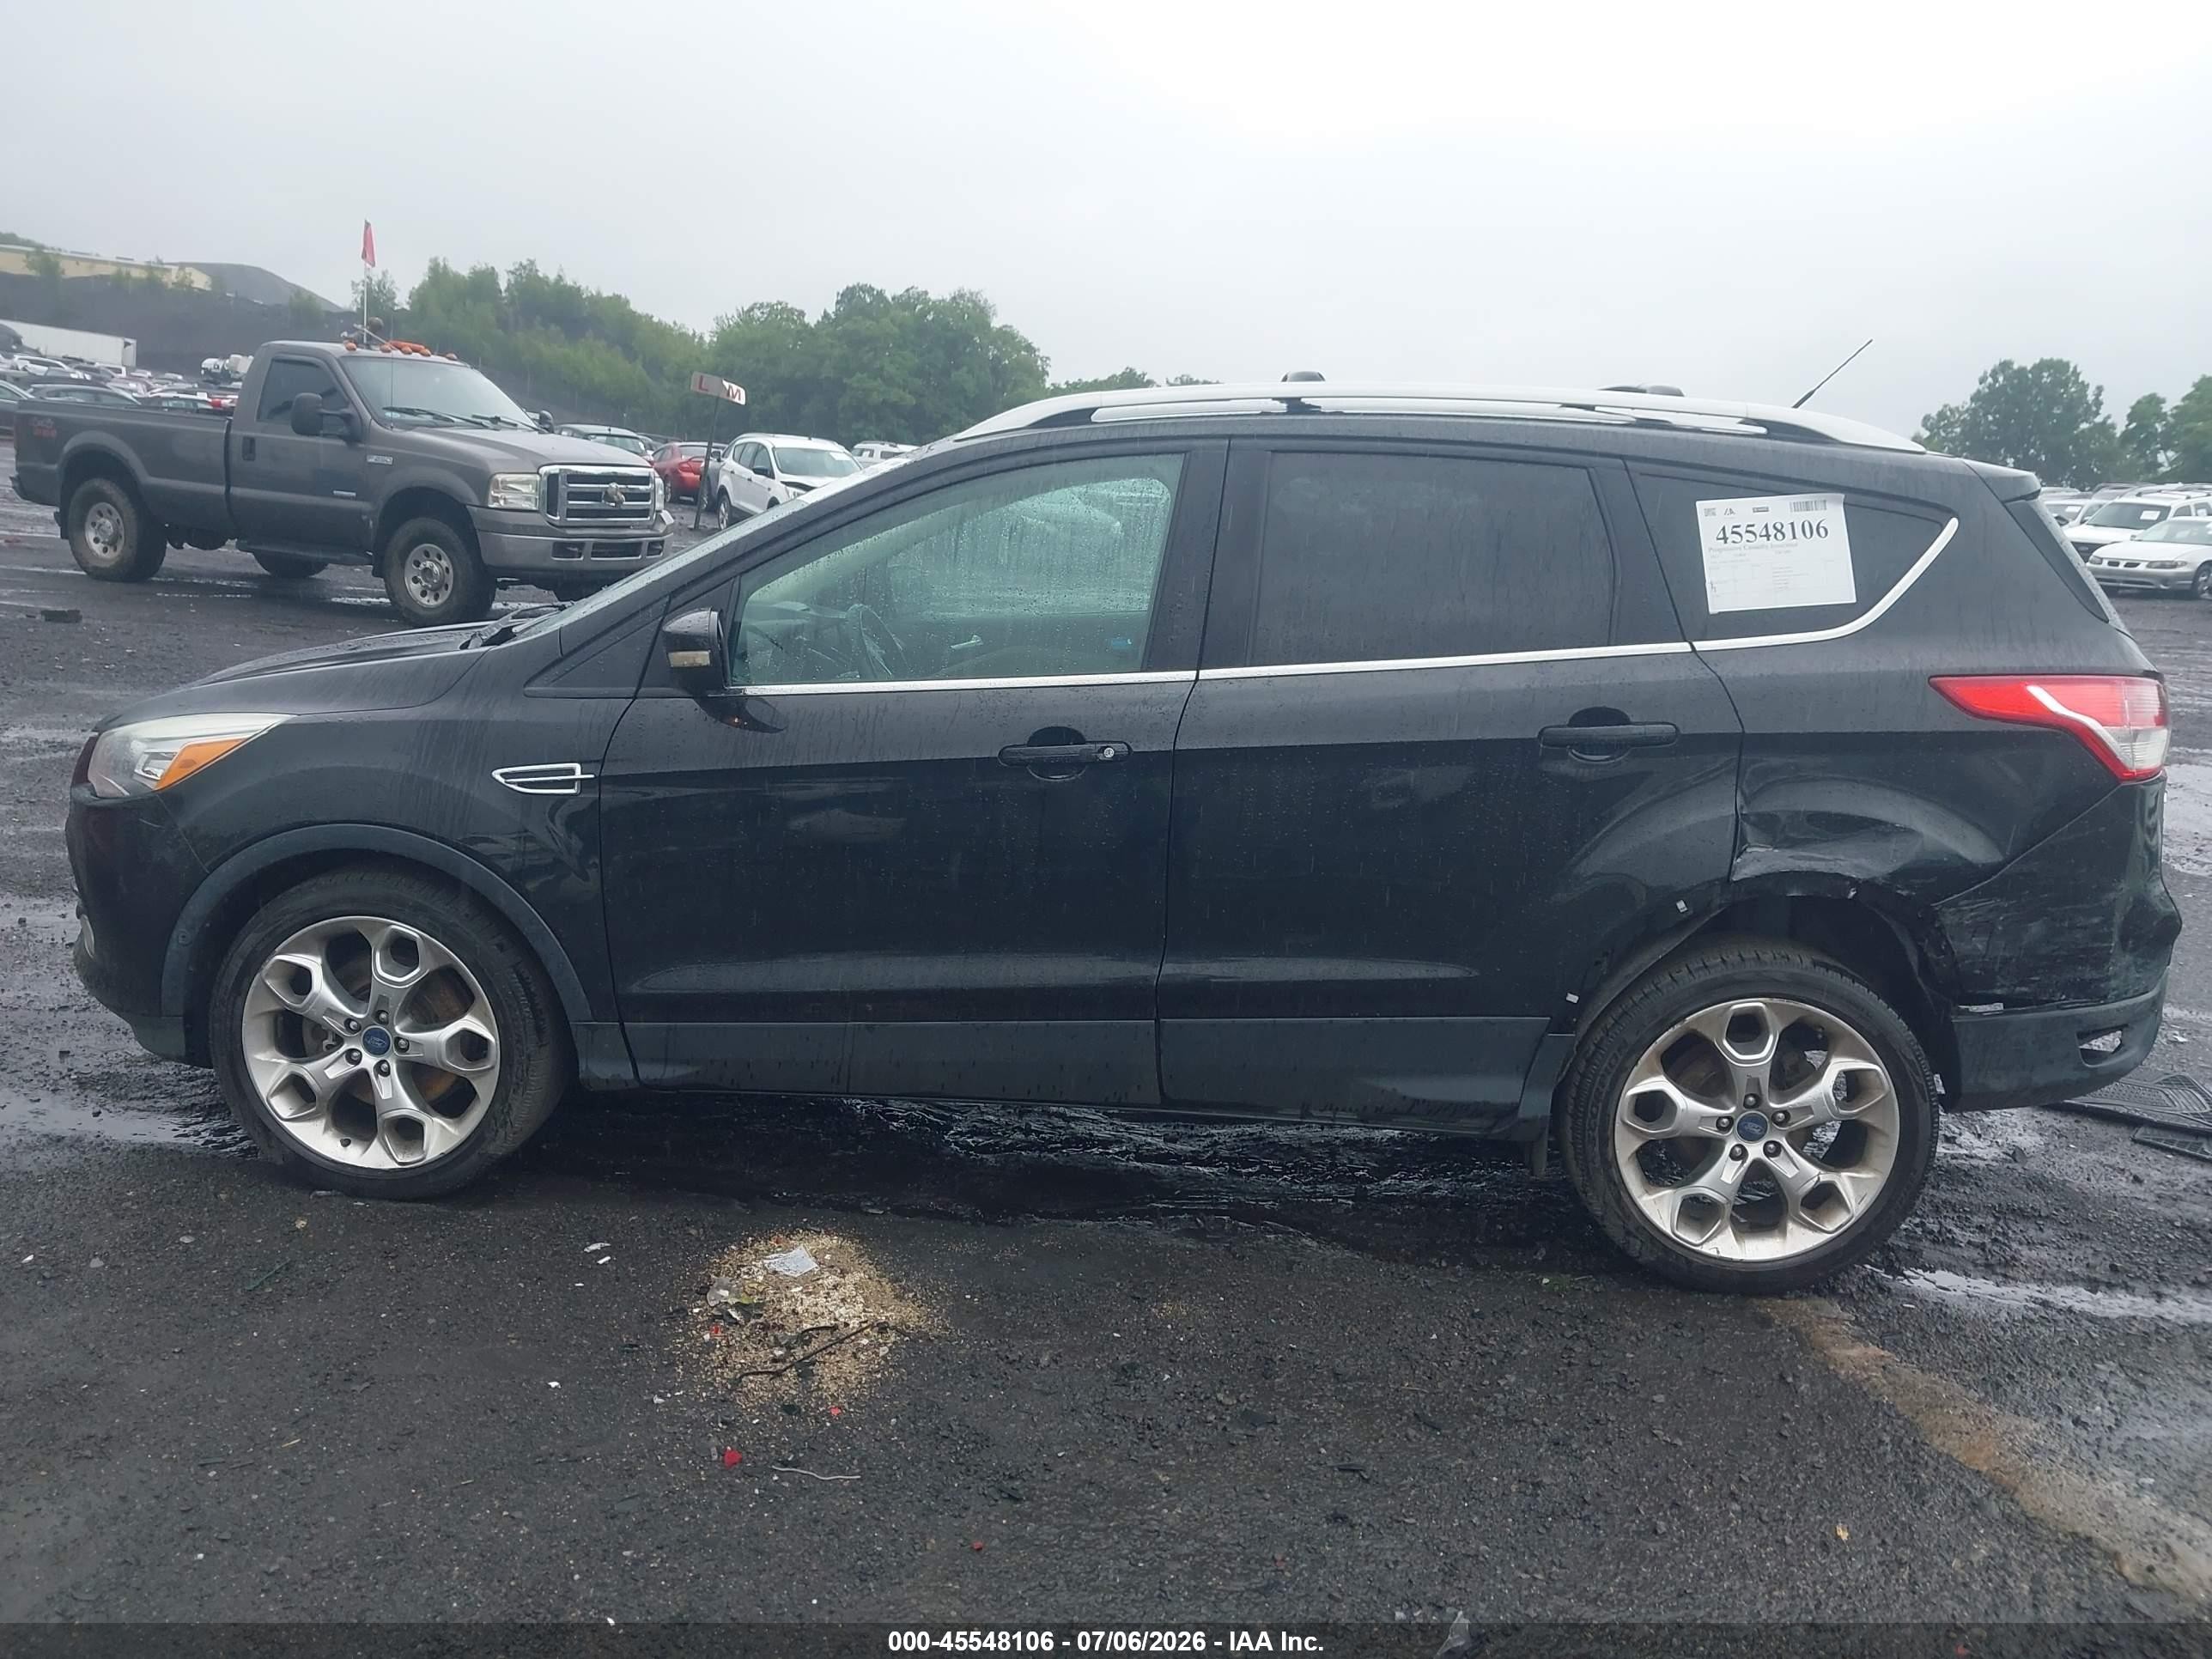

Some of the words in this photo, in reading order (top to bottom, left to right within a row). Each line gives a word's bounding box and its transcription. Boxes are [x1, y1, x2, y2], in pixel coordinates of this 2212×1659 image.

[698, 375, 708, 392] L
[727, 385, 741, 401] M
[1716, 519, 1829, 544] 45548106
